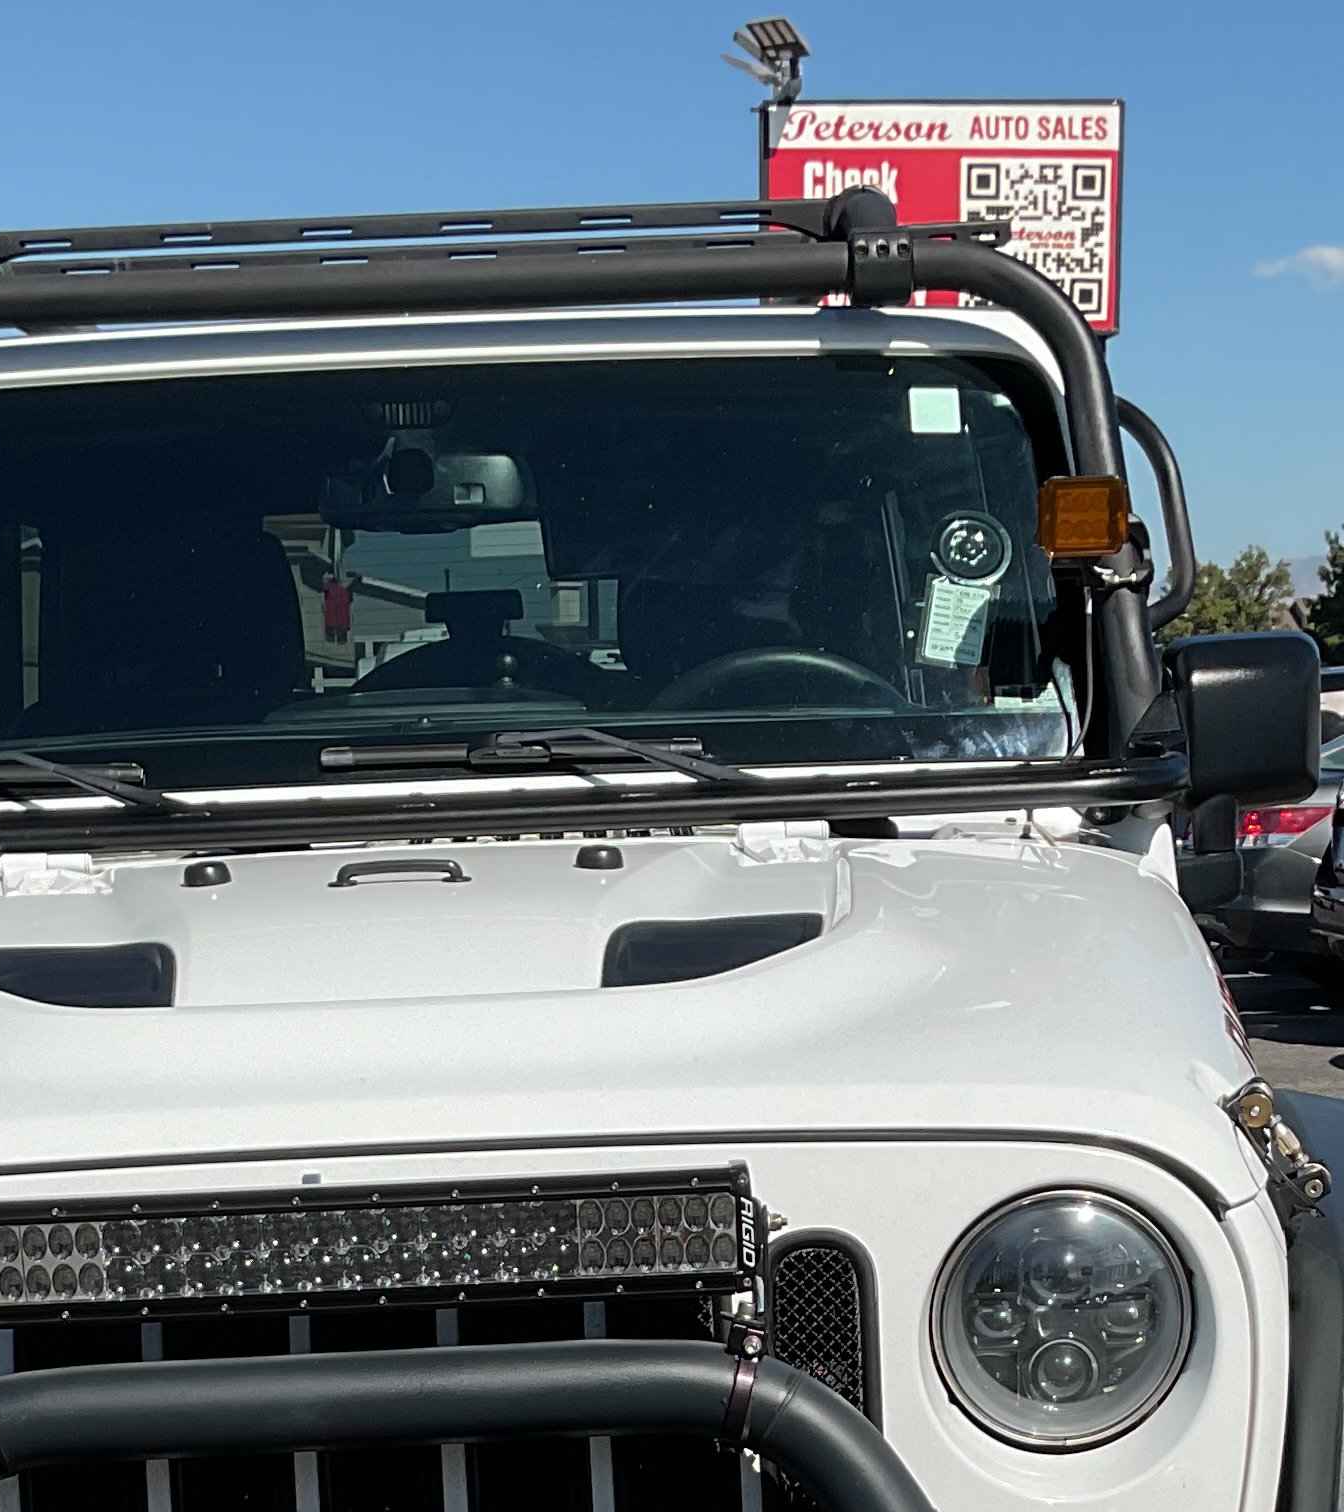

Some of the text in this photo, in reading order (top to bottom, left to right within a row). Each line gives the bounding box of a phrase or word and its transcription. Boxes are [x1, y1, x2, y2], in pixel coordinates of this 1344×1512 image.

[782, 110, 1107, 142] Peterson AUTO SALES
[1011, 227, 1075, 241] eterson
[740, 1196, 756, 1268] RIGID
